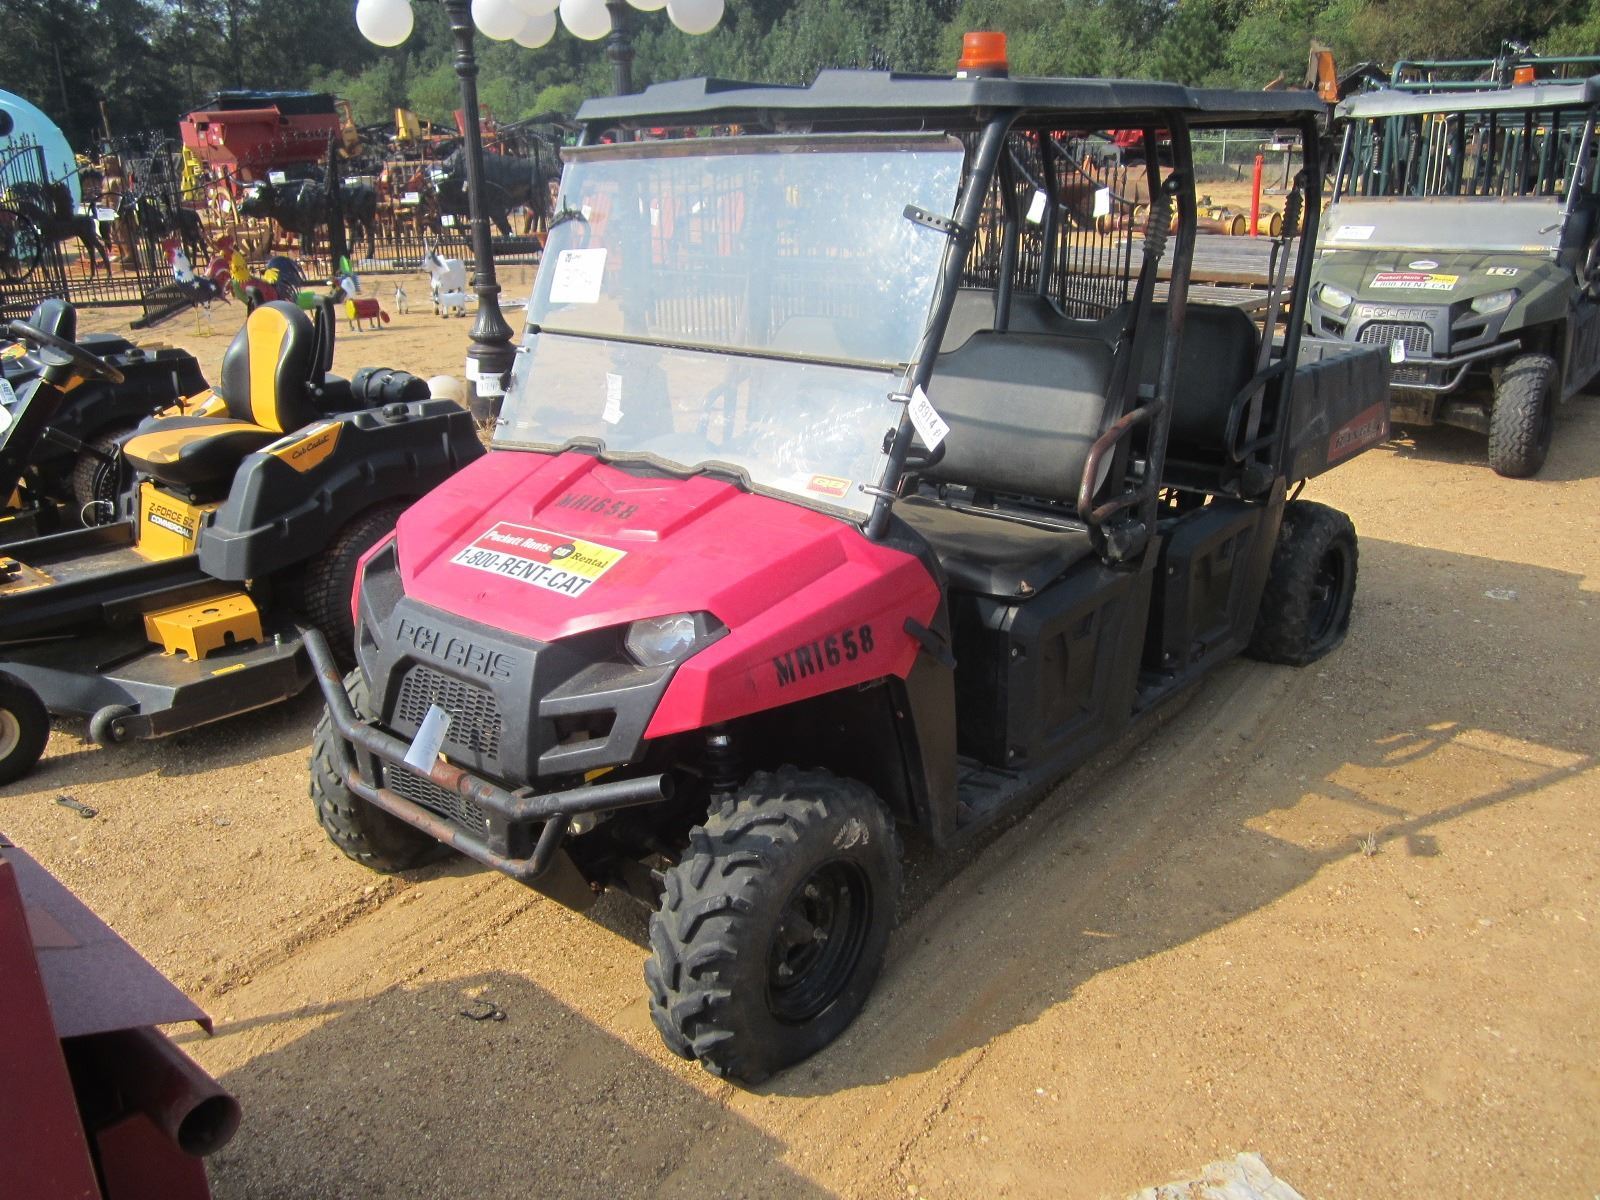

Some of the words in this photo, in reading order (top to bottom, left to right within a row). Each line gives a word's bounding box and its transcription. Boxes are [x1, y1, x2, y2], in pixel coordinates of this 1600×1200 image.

[1361, 306, 1440, 320] POLARIS
[149, 502, 182, 523] Z-FORCE
[520, 537, 552, 554] Rents
[552, 545, 572, 557] CAT
[571, 551, 609, 569] Rental
[455, 548, 592, 595] 1-800-RENT-CAT
[396, 618, 517, 684] POLARIS
